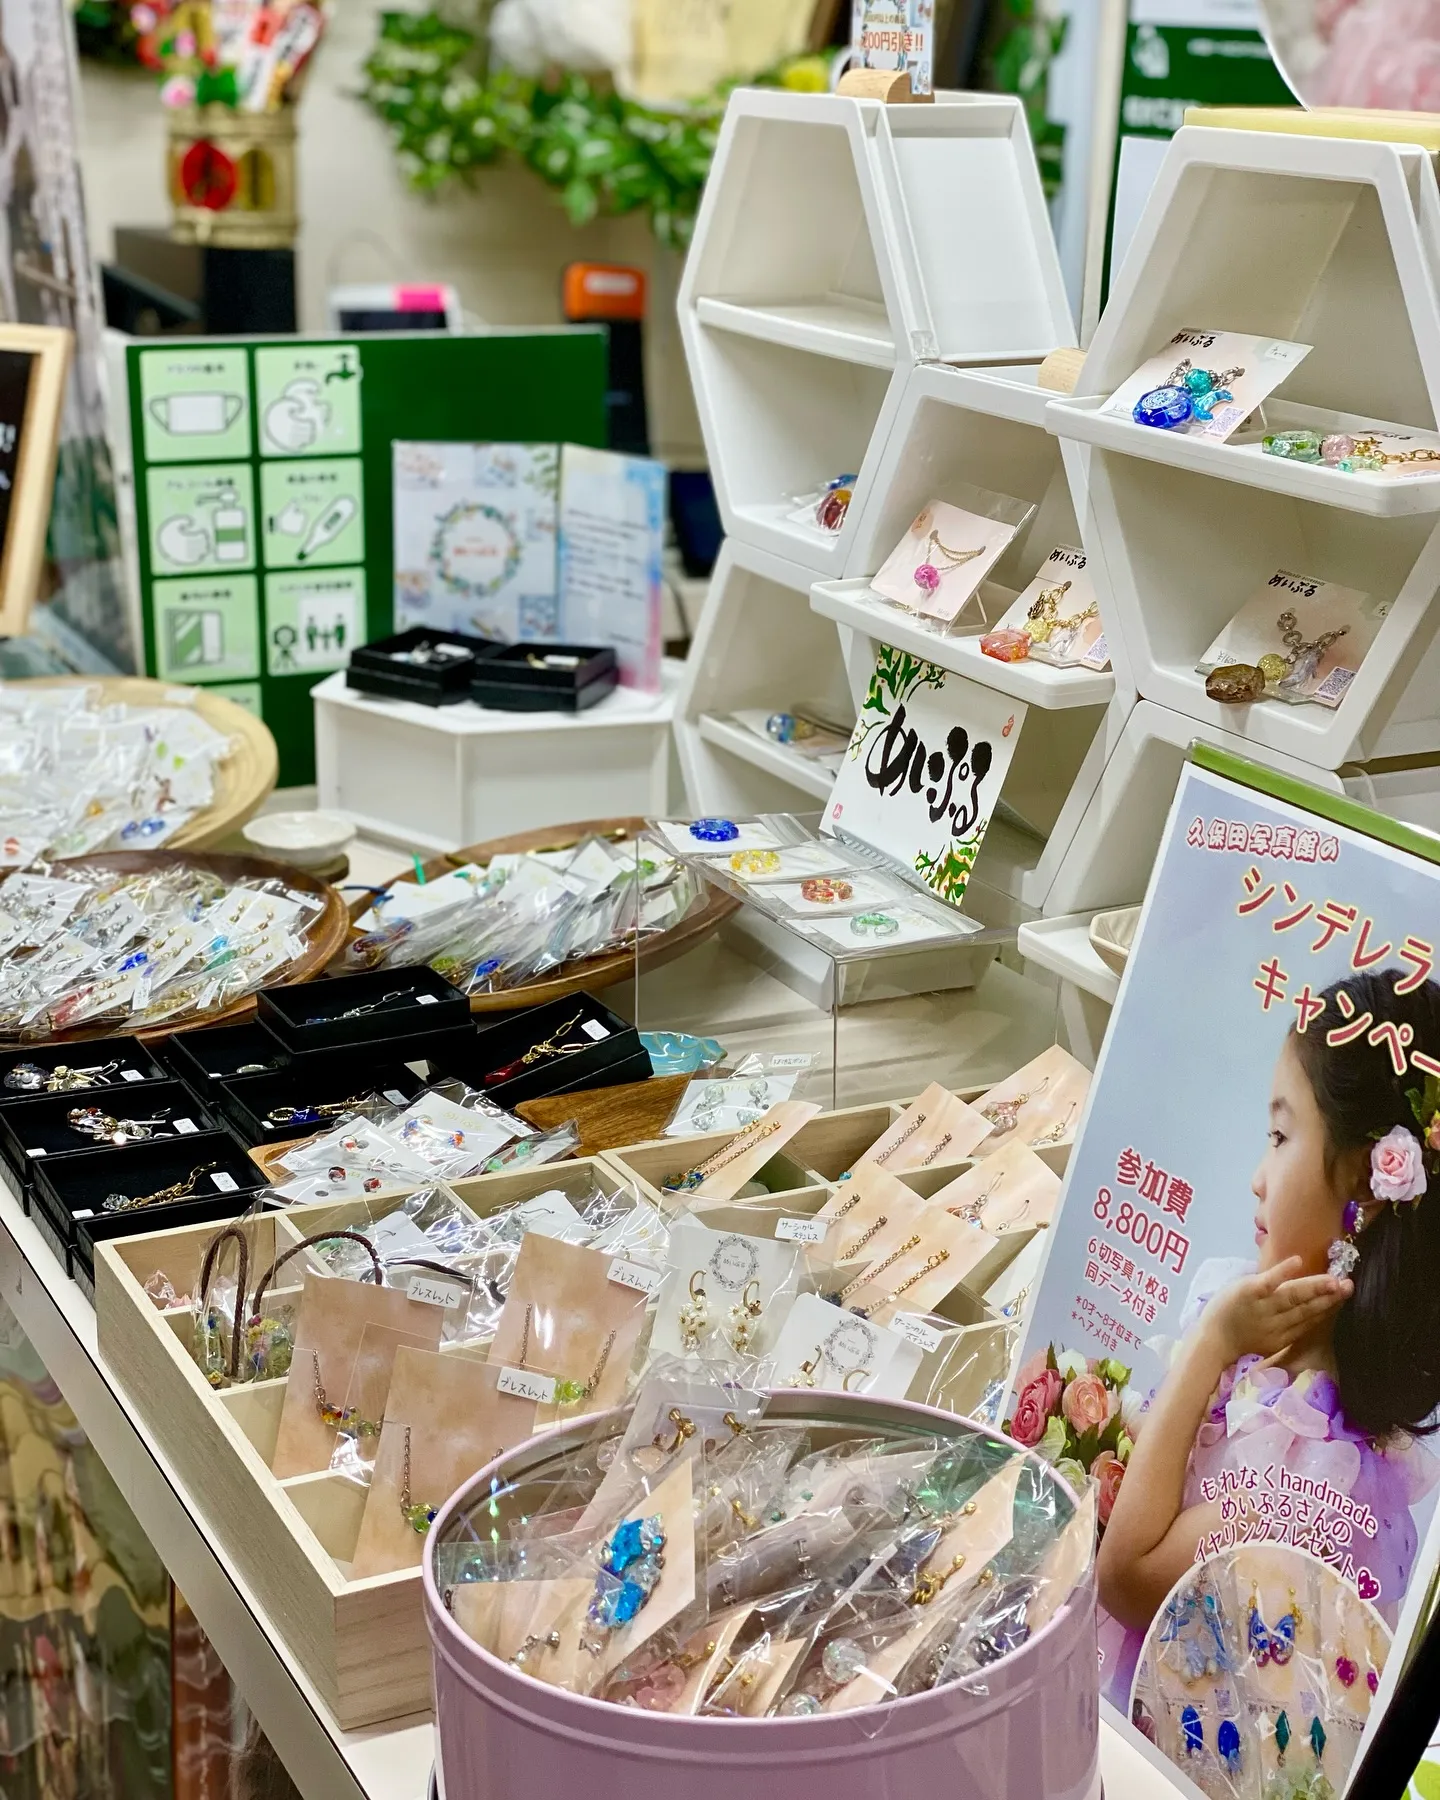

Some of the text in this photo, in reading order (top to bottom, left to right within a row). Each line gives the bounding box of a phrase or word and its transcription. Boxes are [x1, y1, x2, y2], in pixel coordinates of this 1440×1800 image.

[1187, 817, 1340, 862] 久保田写真館の
[1238, 867, 1433, 993] シンデレラ
[1117, 1148, 1193, 1223] 参加費
[1093, 1188, 1190, 1274] 8,800円
[1085, 1261, 1157, 1323] 同データ付き
[1194, 1518, 1355, 1578] イヤリングプレゼント
[1222, 1493, 1352, 1544] めいぷるさんの
